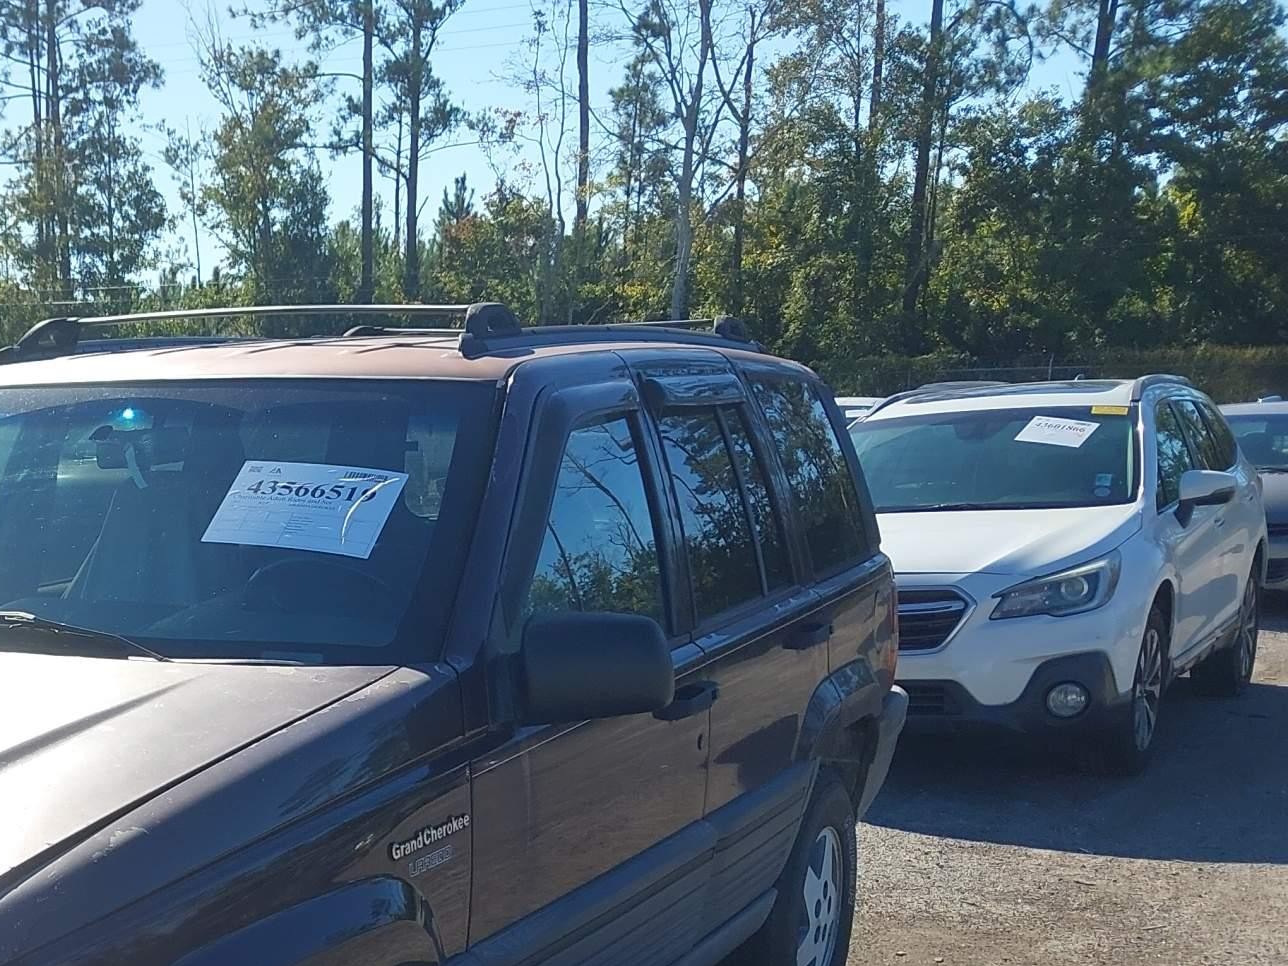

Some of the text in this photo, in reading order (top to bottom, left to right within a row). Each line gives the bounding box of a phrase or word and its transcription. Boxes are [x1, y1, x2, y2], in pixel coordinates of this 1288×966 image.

[247, 479, 379, 503] 43566519
[391, 814, 470, 860] Grand Cherokee
